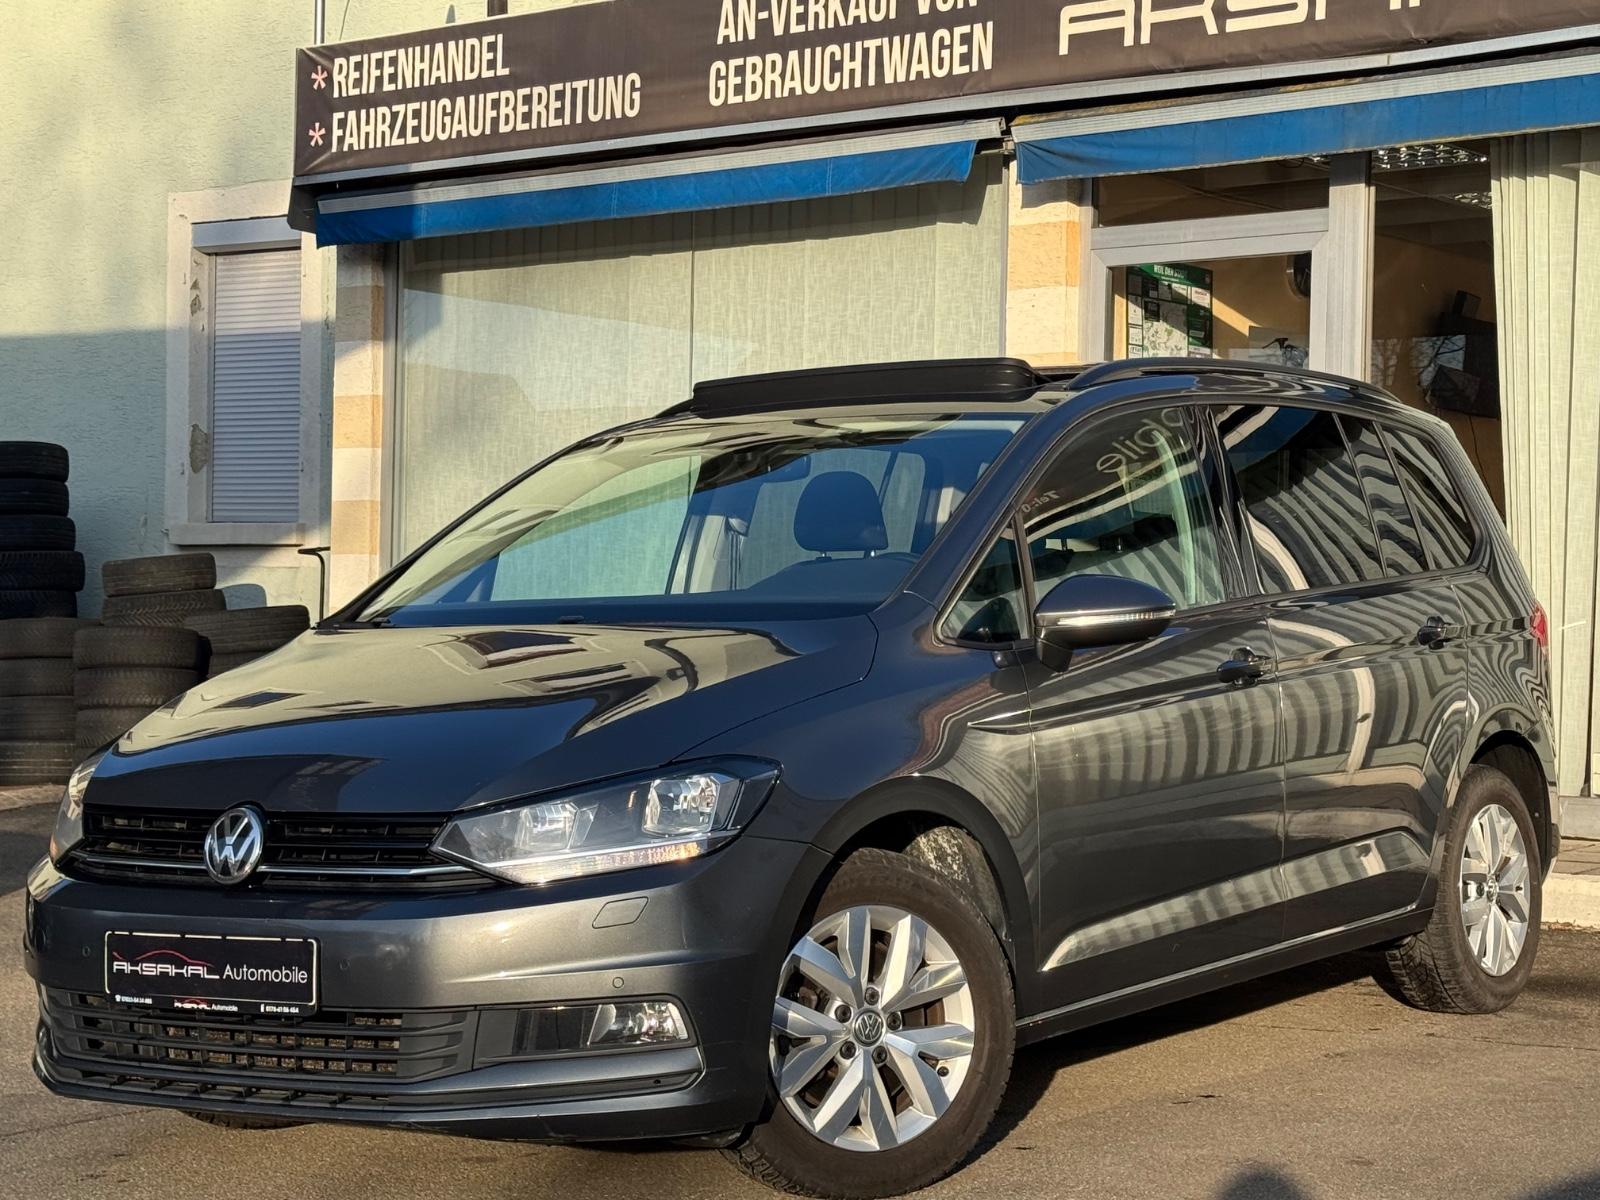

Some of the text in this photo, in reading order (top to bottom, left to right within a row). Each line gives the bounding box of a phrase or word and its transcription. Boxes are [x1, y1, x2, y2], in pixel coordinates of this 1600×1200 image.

[332, 33, 510, 98] REIFENHANDEL
[708, 21, 994, 107] GEBRAUCHTWAGEN
[331, 72, 642, 152] FAHRZEUGAUFBEREITUNG
[112, 961, 308, 984] AKSAKAL Automobile
